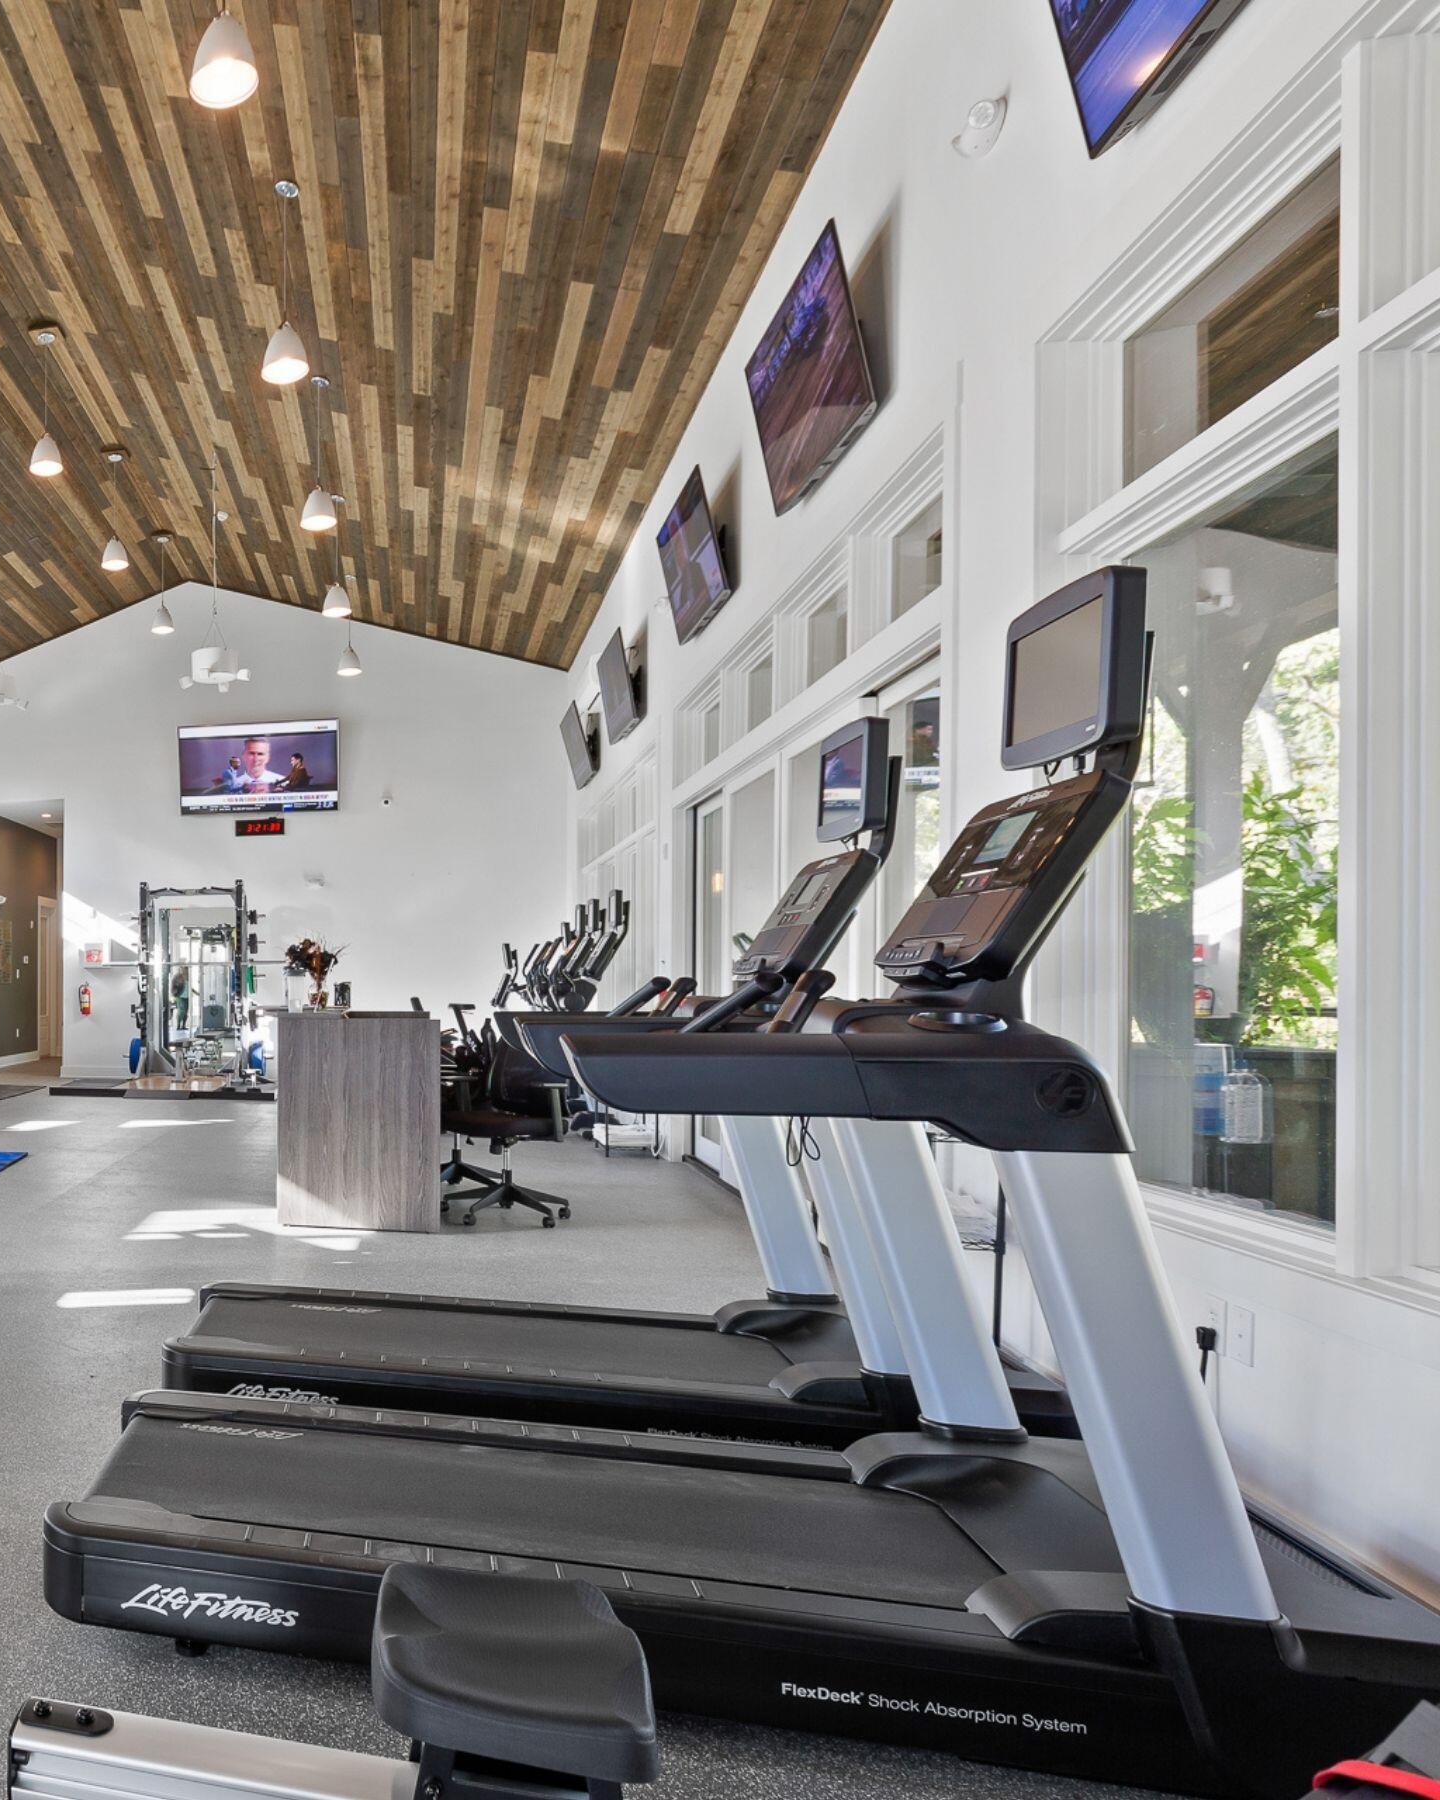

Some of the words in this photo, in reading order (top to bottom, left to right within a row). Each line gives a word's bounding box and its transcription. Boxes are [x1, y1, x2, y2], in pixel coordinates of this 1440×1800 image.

[868, 1693, 921, 1714] Shock
[924, 1701, 1018, 1725] Absorption
[1022, 1713, 1088, 1735] System
